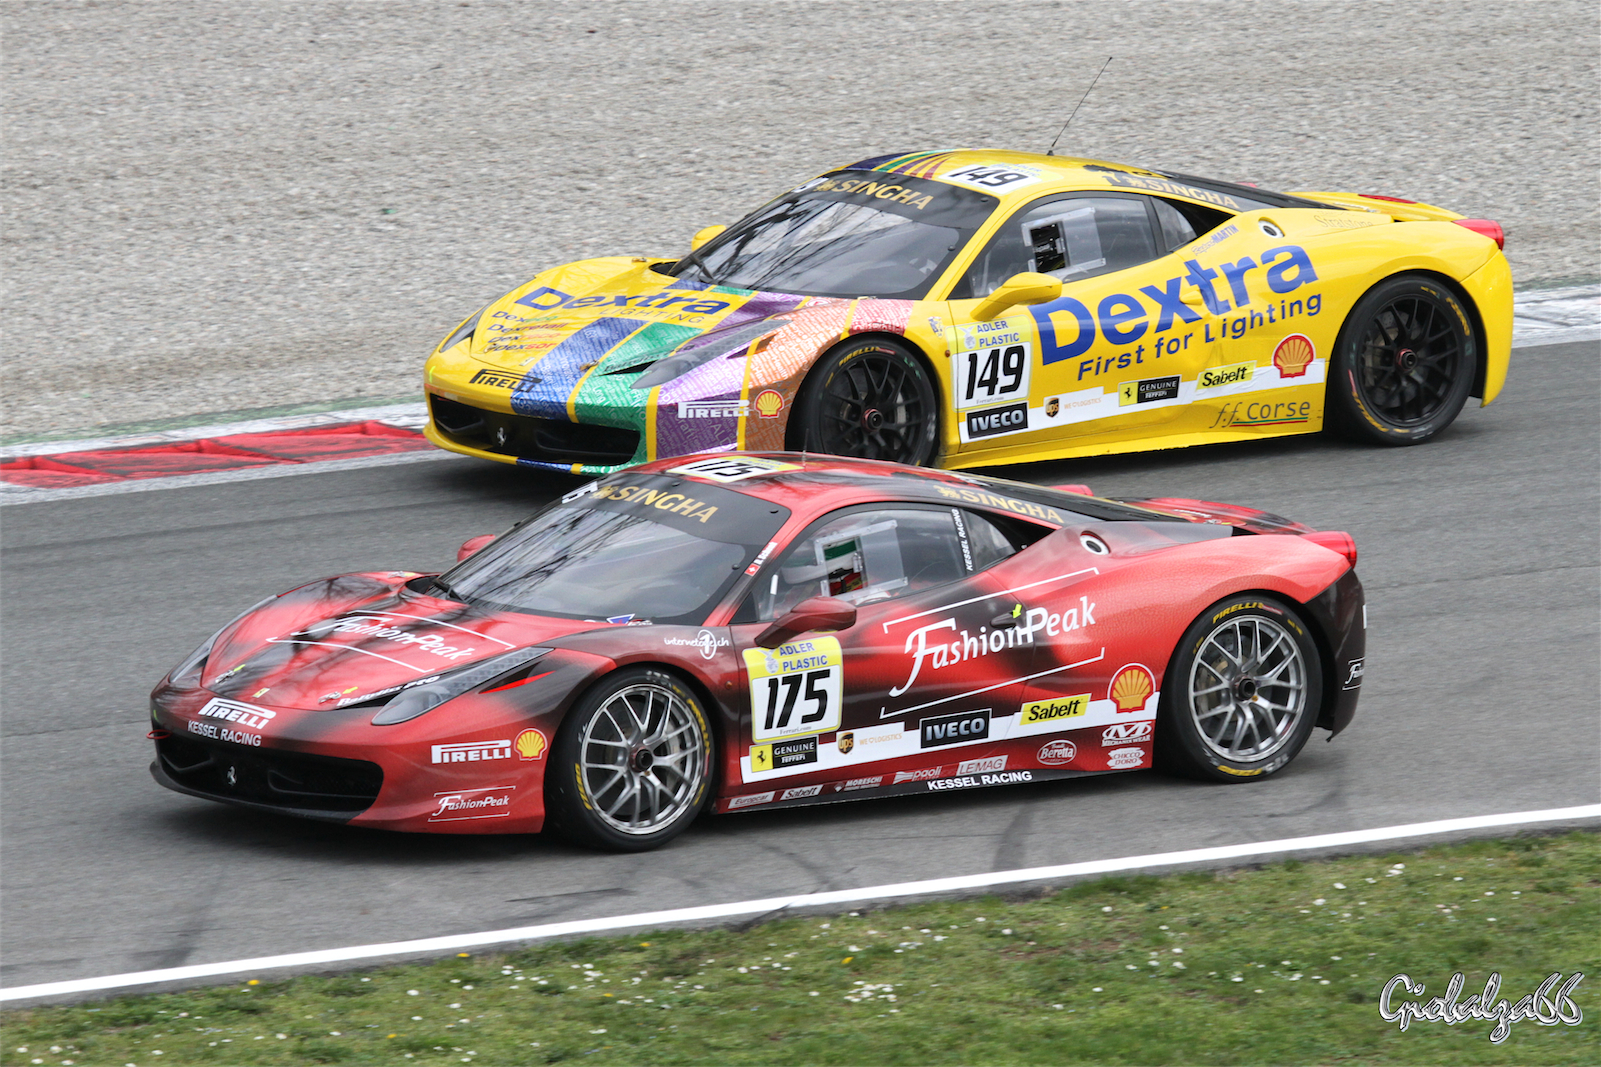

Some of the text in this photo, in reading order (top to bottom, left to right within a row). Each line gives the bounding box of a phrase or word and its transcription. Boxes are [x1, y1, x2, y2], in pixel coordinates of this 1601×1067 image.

[949, 167, 1029, 187] 149
[831, 179, 934, 210] SINGHA
[1146, 179, 1240, 208] SINGHA
[514, 286, 730, 315] Dextra
[1028, 245, 1319, 366] Dextra
[600, 308, 706, 324] LIGHTING
[976, 320, 1009, 333] ADLER
[979, 332, 1019, 348] PLASTIC
[1077, 293, 1321, 381] First for Lighting
[468, 369, 542, 393] PIRELLI
[965, 345, 1025, 400] 149
[1202, 366, 1247, 387] Sabelt
[1139, 380, 1177, 392] GENUINE
[677, 398, 750, 419] PIRELLI
[1247, 401, 1311, 420] Corse
[971, 410, 1024, 432] IVECO
[610, 485, 718, 523] SINGHA
[962, 489, 1064, 523] SINGHA
[951, 508, 974, 571] KESSEL RACING
[1213, 602, 1257, 624] PIRELLI
[779, 642, 815, 657] ADLER
[888, 596, 1096, 697] FashionPeak
[782, 655, 828, 671] PLASTIC
[764, 668, 830, 730] 175
[1028, 699, 1080, 721] Sabelt
[198, 697, 276, 729] PIRELLI
[187, 720, 261, 747] KESSEL RACING
[925, 718, 985, 740] IVECO
[431, 739, 512, 764] PIRELLI
[773, 742, 815, 756] GENUINE
[1040, 746, 1073, 759] Beretta
[912, 766, 942, 781] paoli
[927, 770, 1033, 791] KESSEL RACING
[785, 787, 818, 799] Sabelt
